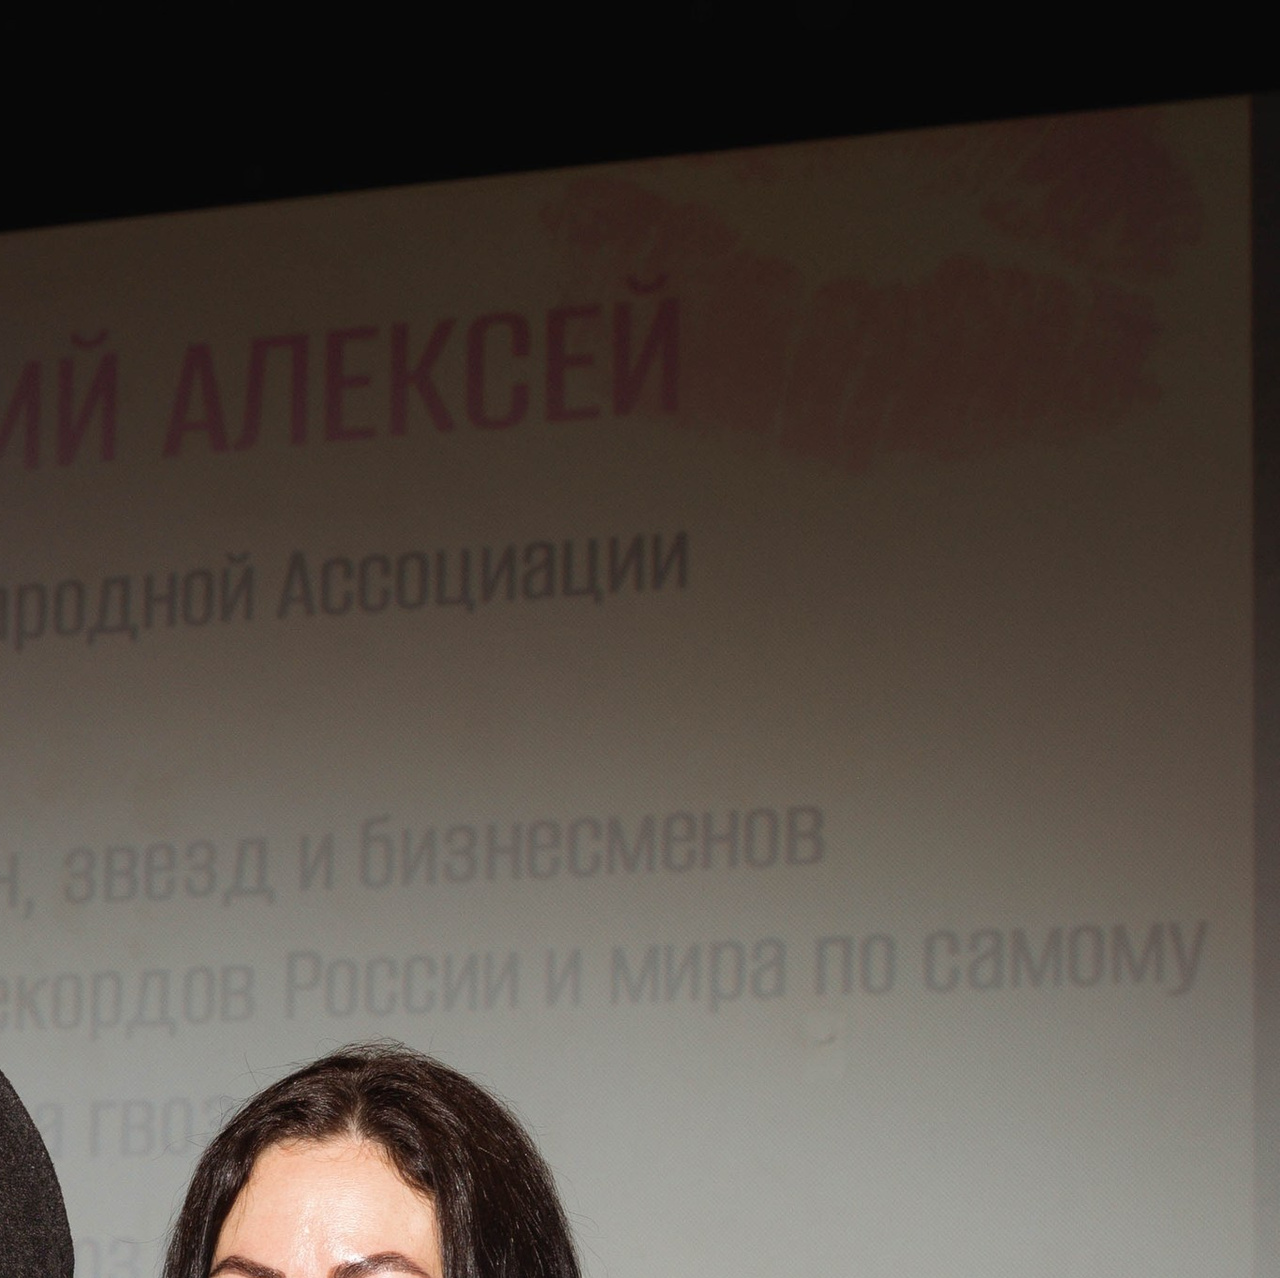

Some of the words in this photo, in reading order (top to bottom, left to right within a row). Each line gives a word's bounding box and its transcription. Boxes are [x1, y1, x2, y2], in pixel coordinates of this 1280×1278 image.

[161, 274, 682, 458] АЛЕКСЕЙ
[276, 530, 690, 619] Ассоциации
[62, 834, 276, 905] звезд
[297, 830, 334, 891] и
[360, 805, 824, 890] бизнесменов
[284, 948, 518, 1023] России
[544, 947, 583, 1008] и
[609, 939, 787, 1014] мира
[814, 931, 897, 998] по
[923, 918, 1211, 998] самому
